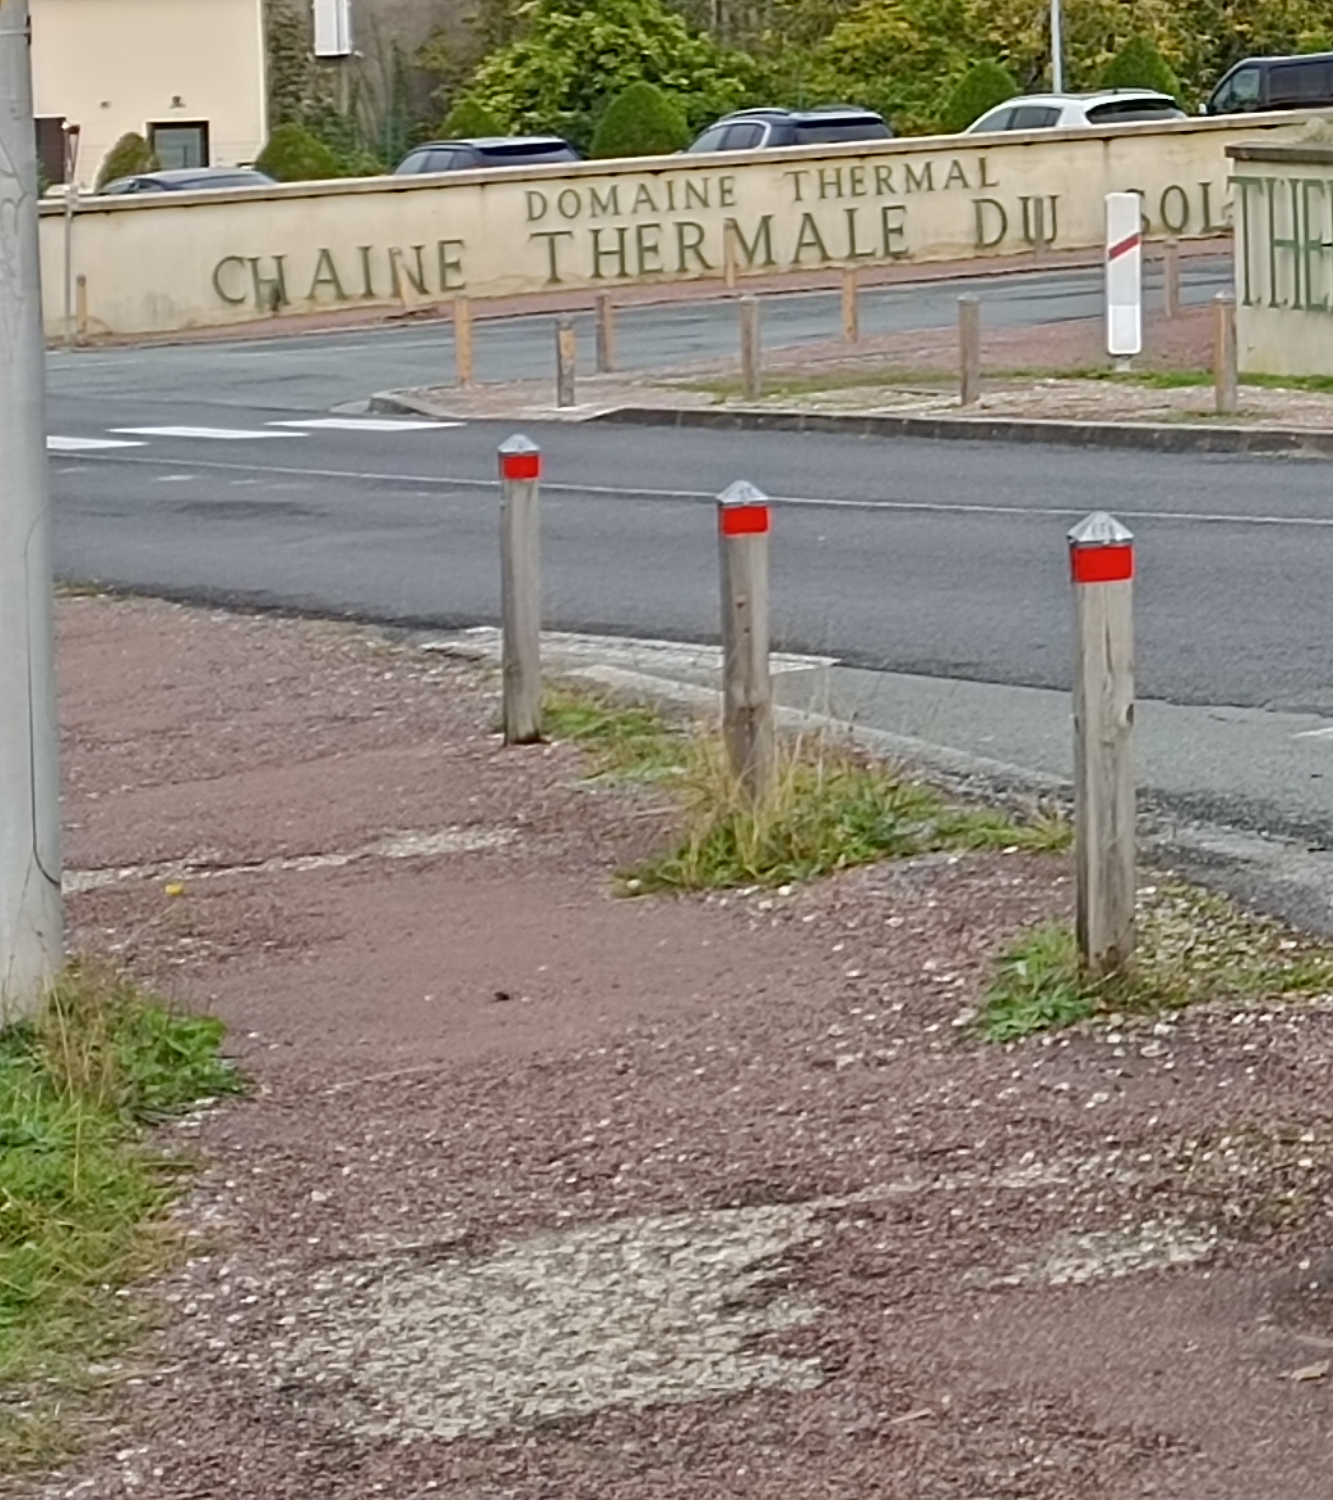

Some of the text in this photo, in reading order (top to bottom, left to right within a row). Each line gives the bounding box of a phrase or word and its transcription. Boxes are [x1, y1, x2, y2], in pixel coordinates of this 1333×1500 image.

[524, 157, 999, 222] DOMAINE THERMAL
[212, 239, 466, 309] CHAINE
[529, 204, 910, 284] THERMALE
[971, 195, 1061, 249] DU
